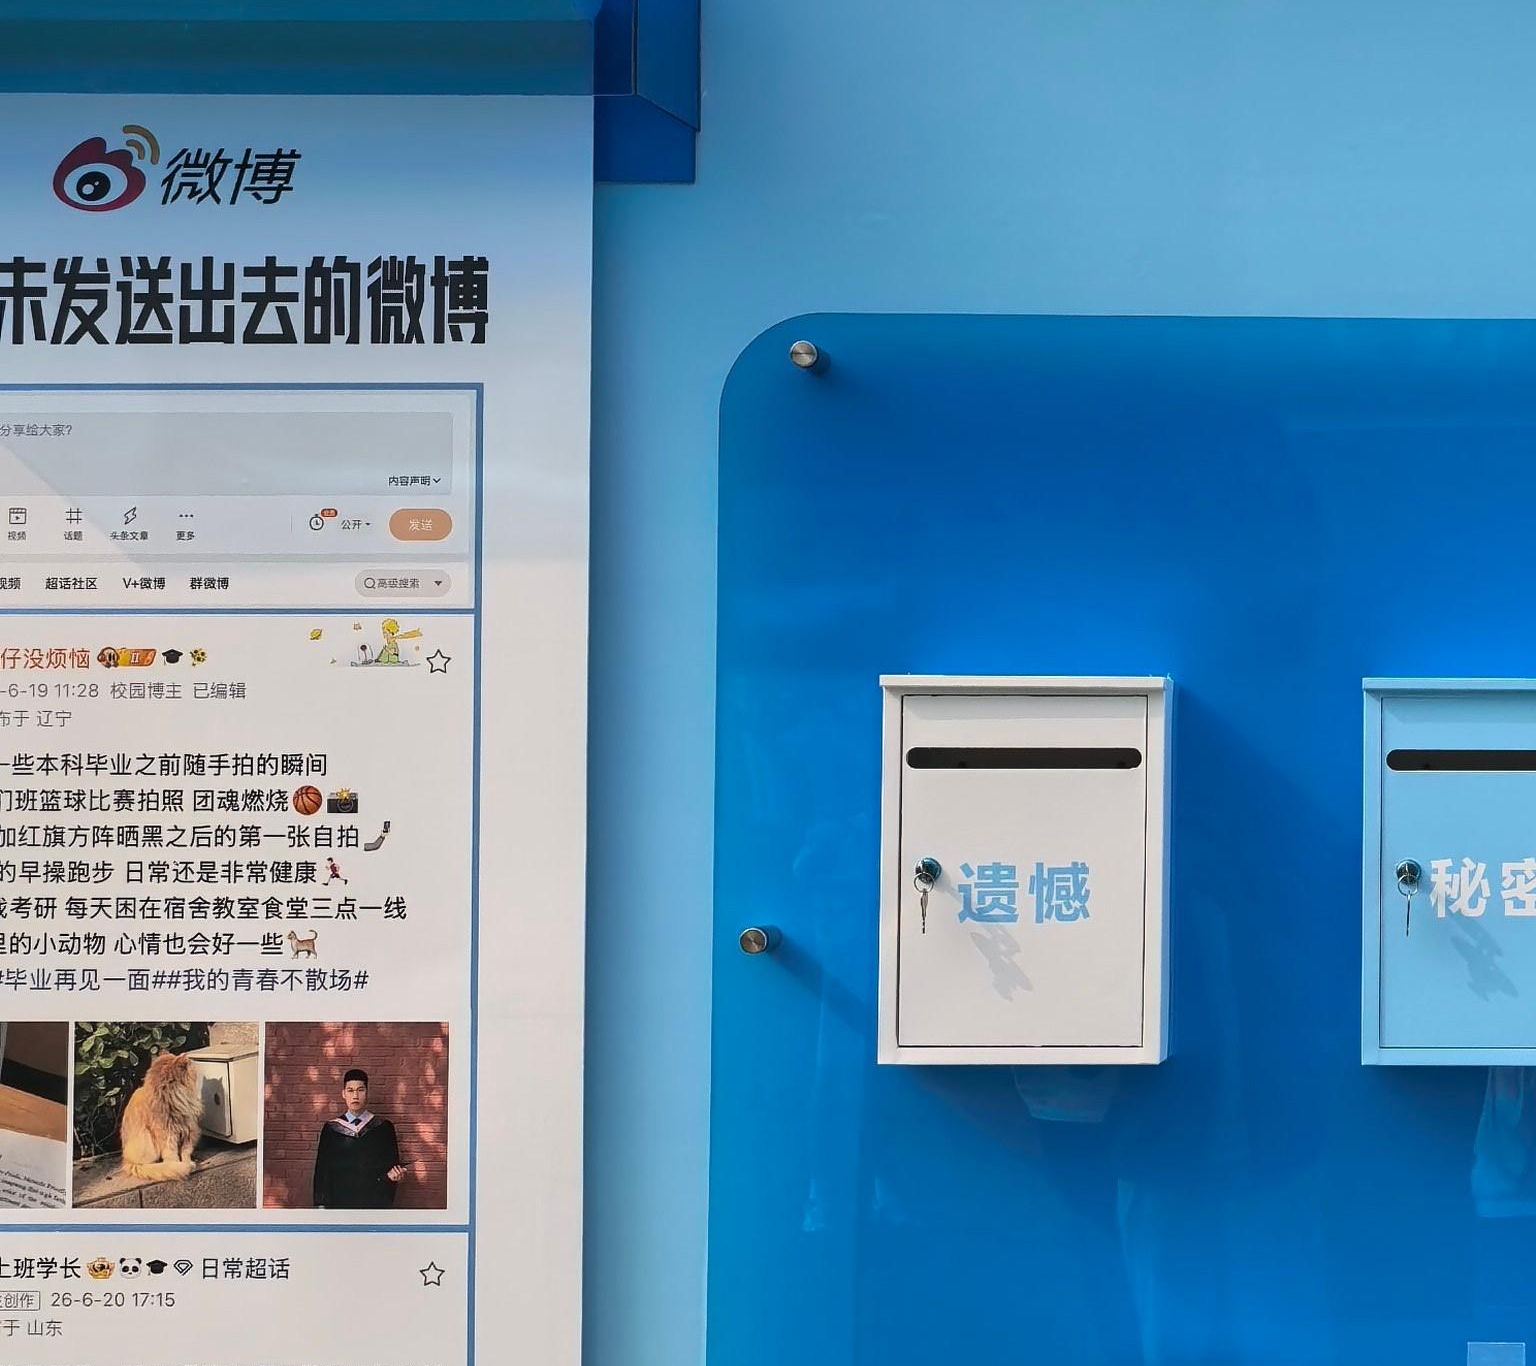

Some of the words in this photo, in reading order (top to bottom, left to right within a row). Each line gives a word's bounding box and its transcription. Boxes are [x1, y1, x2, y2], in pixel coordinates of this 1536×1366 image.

[161, 148, 301, 205] 微博
[0, 255, 489, 345] 未发送出去的微博
[389, 476, 430, 486] 内容声明
[8, 531, 27, 540] 视频
[64, 531, 82, 540] 话题
[110, 531, 148, 540] 头条文章
[177, 531, 194, 540] 更多
[341, 520, 361, 530] 公开
[409, 520, 432, 531] 发送
[46, 578, 97, 589] 超话社区
[123, 577, 165, 590] V+微博
[190, 577, 229, 589] 群微博
[378, 579, 420, 588] 高级搜索
[1, 648, 90, 669] 仔没烦恼
[55, 684, 98, 697] 11:28
[111, 682, 181, 699] 校园博主
[194, 682, 246, 699] 已编辑
[37, 710, 71, 727] 辽宁
[194, 789, 288, 812] 团魂燃烧
[0, 861, 114, 883] 的早操跑步
[127, 860, 317, 883] 日常还是非常健康
[956, 861, 1091, 924] 遗憾
[65, 896, 406, 920] 每天困在宿舍教室食堂三点一线
[0, 932, 105, 955] 的小动物
[114, 932, 283, 955] 心情也会好一些
[203, 1258, 290, 1279] 日常超话
[0, 1294, 34, 1308] 创作
[52, 1293, 124, 1307] 26-6-20
[133, 1293, 175, 1307] 17:15
[28, 1320, 62, 1336] 山东
